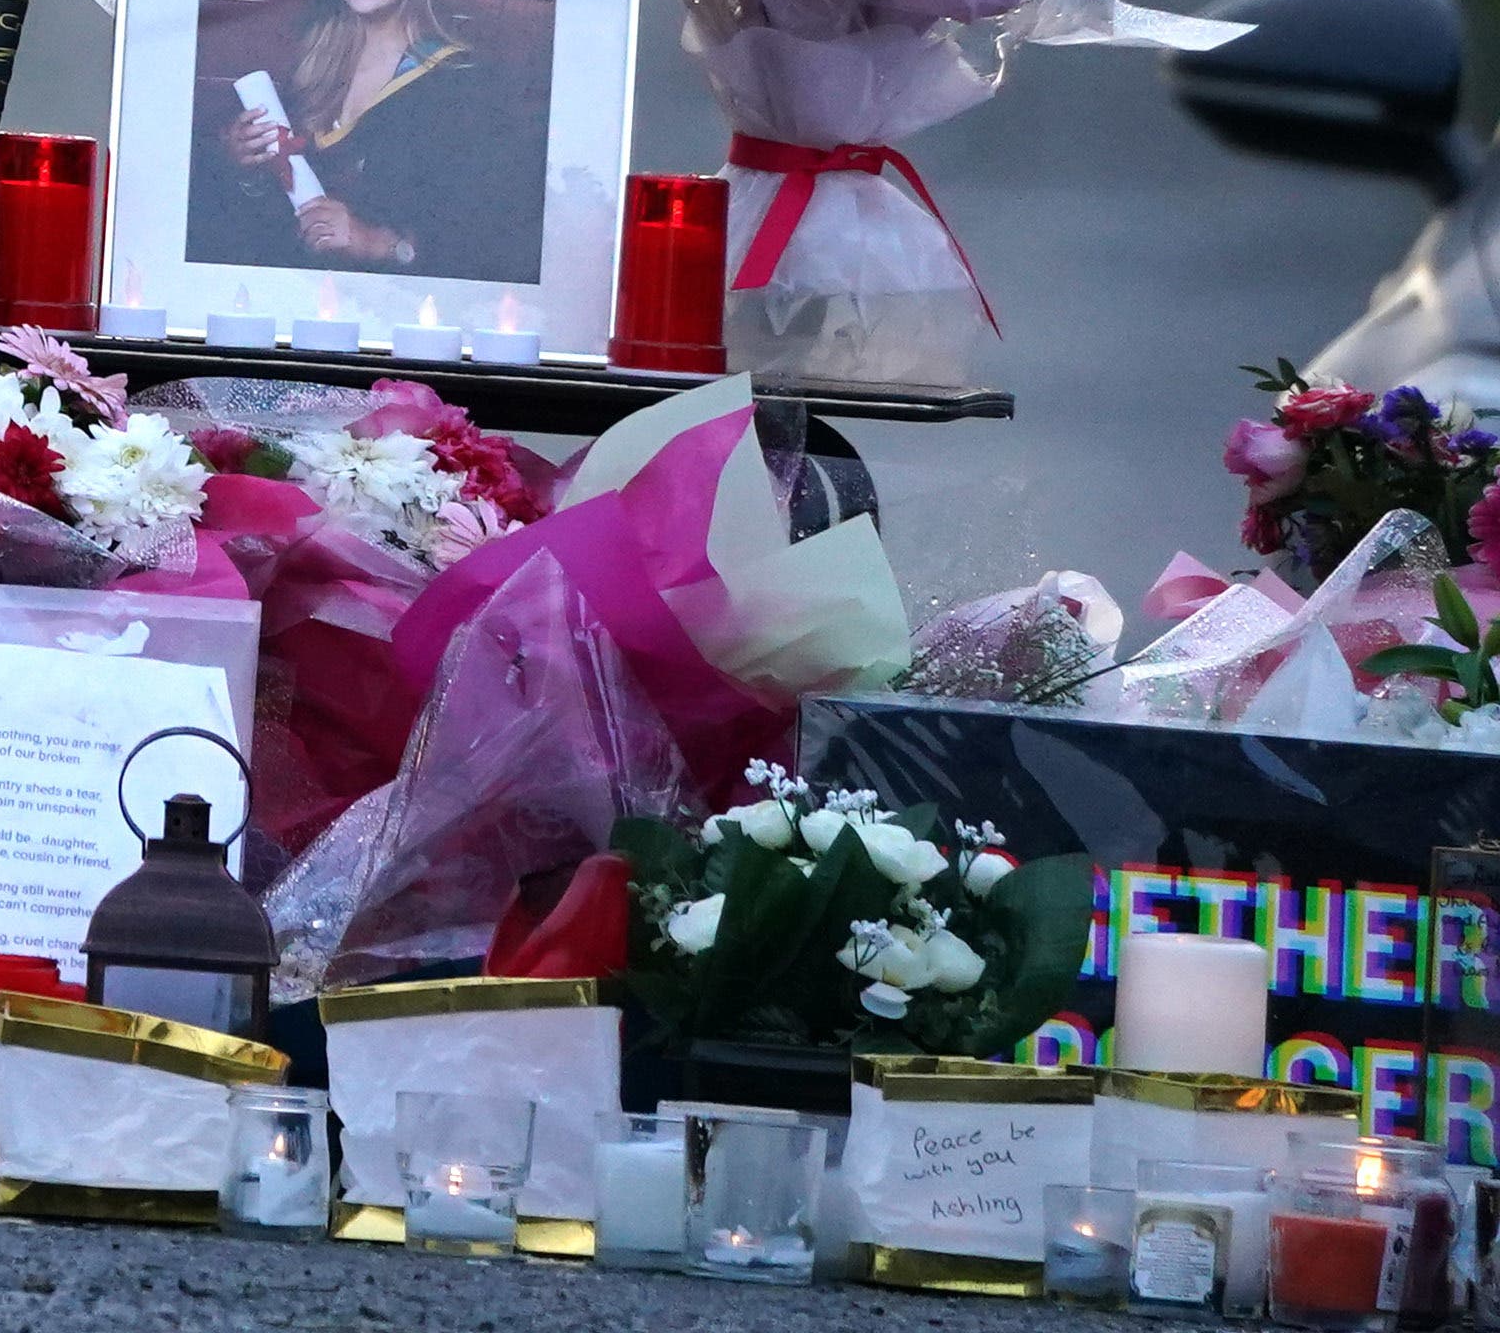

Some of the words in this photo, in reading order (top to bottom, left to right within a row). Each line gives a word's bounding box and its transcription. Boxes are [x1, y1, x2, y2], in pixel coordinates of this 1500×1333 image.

[46, 735, 68, 747] you
[71, 739, 92, 749] are
[0, 745, 12, 757] of
[14, 748, 36, 759] our
[38, 750, 81, 765] broken
[25, 783, 62, 797] sheds
[65, 789, 73, 798] a
[18, 800, 33, 812] an
[36, 802, 97, 817] unspoken
[12, 850, 54, 863] cousin
[57, 854, 70, 864] or
[22, 884, 44, 896] still
[46, 887, 81, 899] water
[30, 903, 93, 917] comprehe
[13, 935, 44, 947] cruel
[913, 1126, 982, 1159] Peace
[1010, 1122, 1036, 1141] be
[904, 1164, 953, 1181] with
[966, 1149, 1017, 1176] you
[931, 1194, 1024, 1224] Ashling
